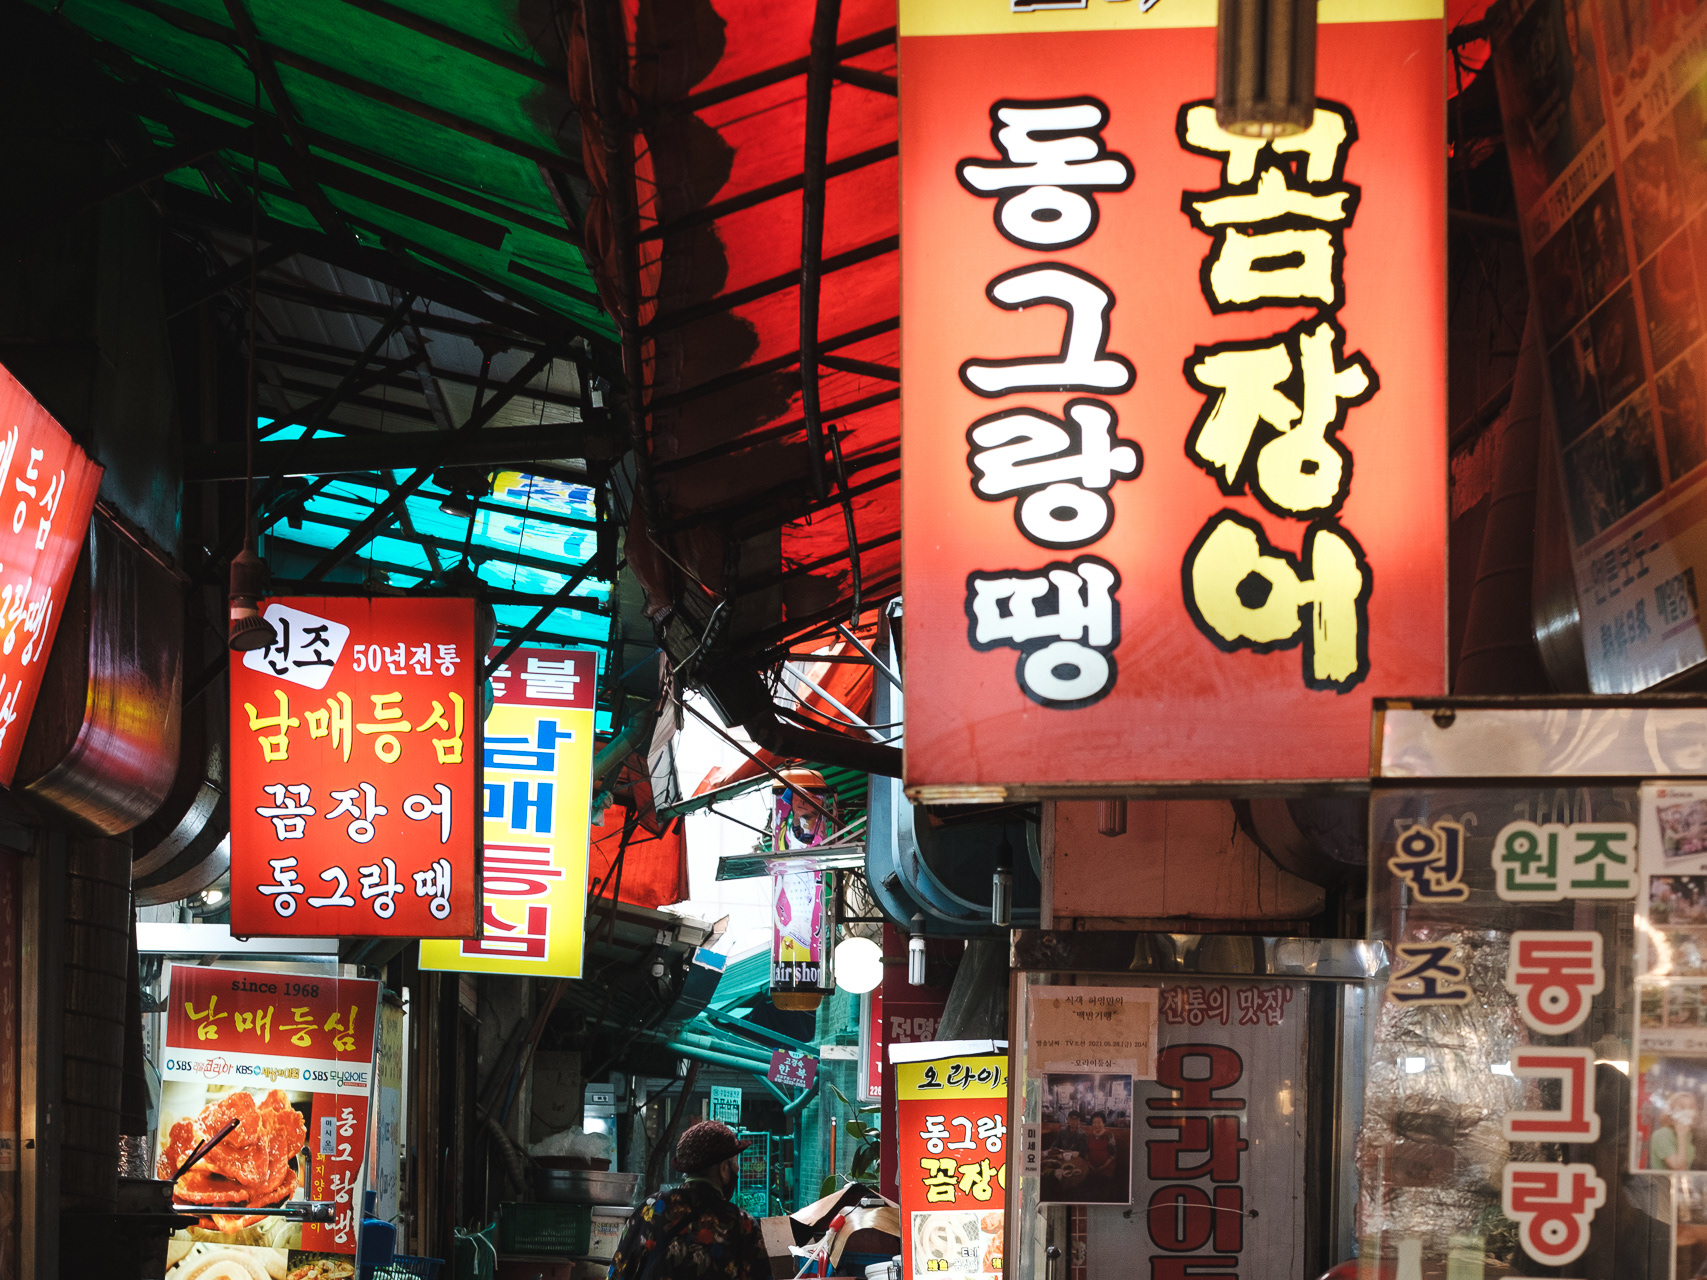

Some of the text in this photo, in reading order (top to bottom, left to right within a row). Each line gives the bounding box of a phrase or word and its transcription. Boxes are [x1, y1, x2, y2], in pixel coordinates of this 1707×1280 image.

[956, 97, 1143, 709] 동그랑땡
[1175, 98, 1380, 693] 꼼장어
[0, 564, 53, 667] 그랑땡
[352, 642, 461, 677] 50년전통
[243, 689, 465, 764] 남매등심
[255, 782, 453, 844] 꼼장어
[256, 856, 453, 920] 동그랑땡
[1498, 826, 1633, 894] 원조
[1386, 821, 1473, 1006] 원조
[231, 977, 320, 998] since 1968
[1160, 985, 1230, 1026] 전통의
[184, 995, 359, 1052] 남매등심
[890, 1016, 943, 1043] 전명
[175, 1060, 192, 1071] SBS
[235, 1065, 254, 1075] KBS
[312, 1070, 329, 1082] SBS
[324, 1107, 357, 1244] 동그랑땡
[1026, 1128, 1037, 1164] 미세요
